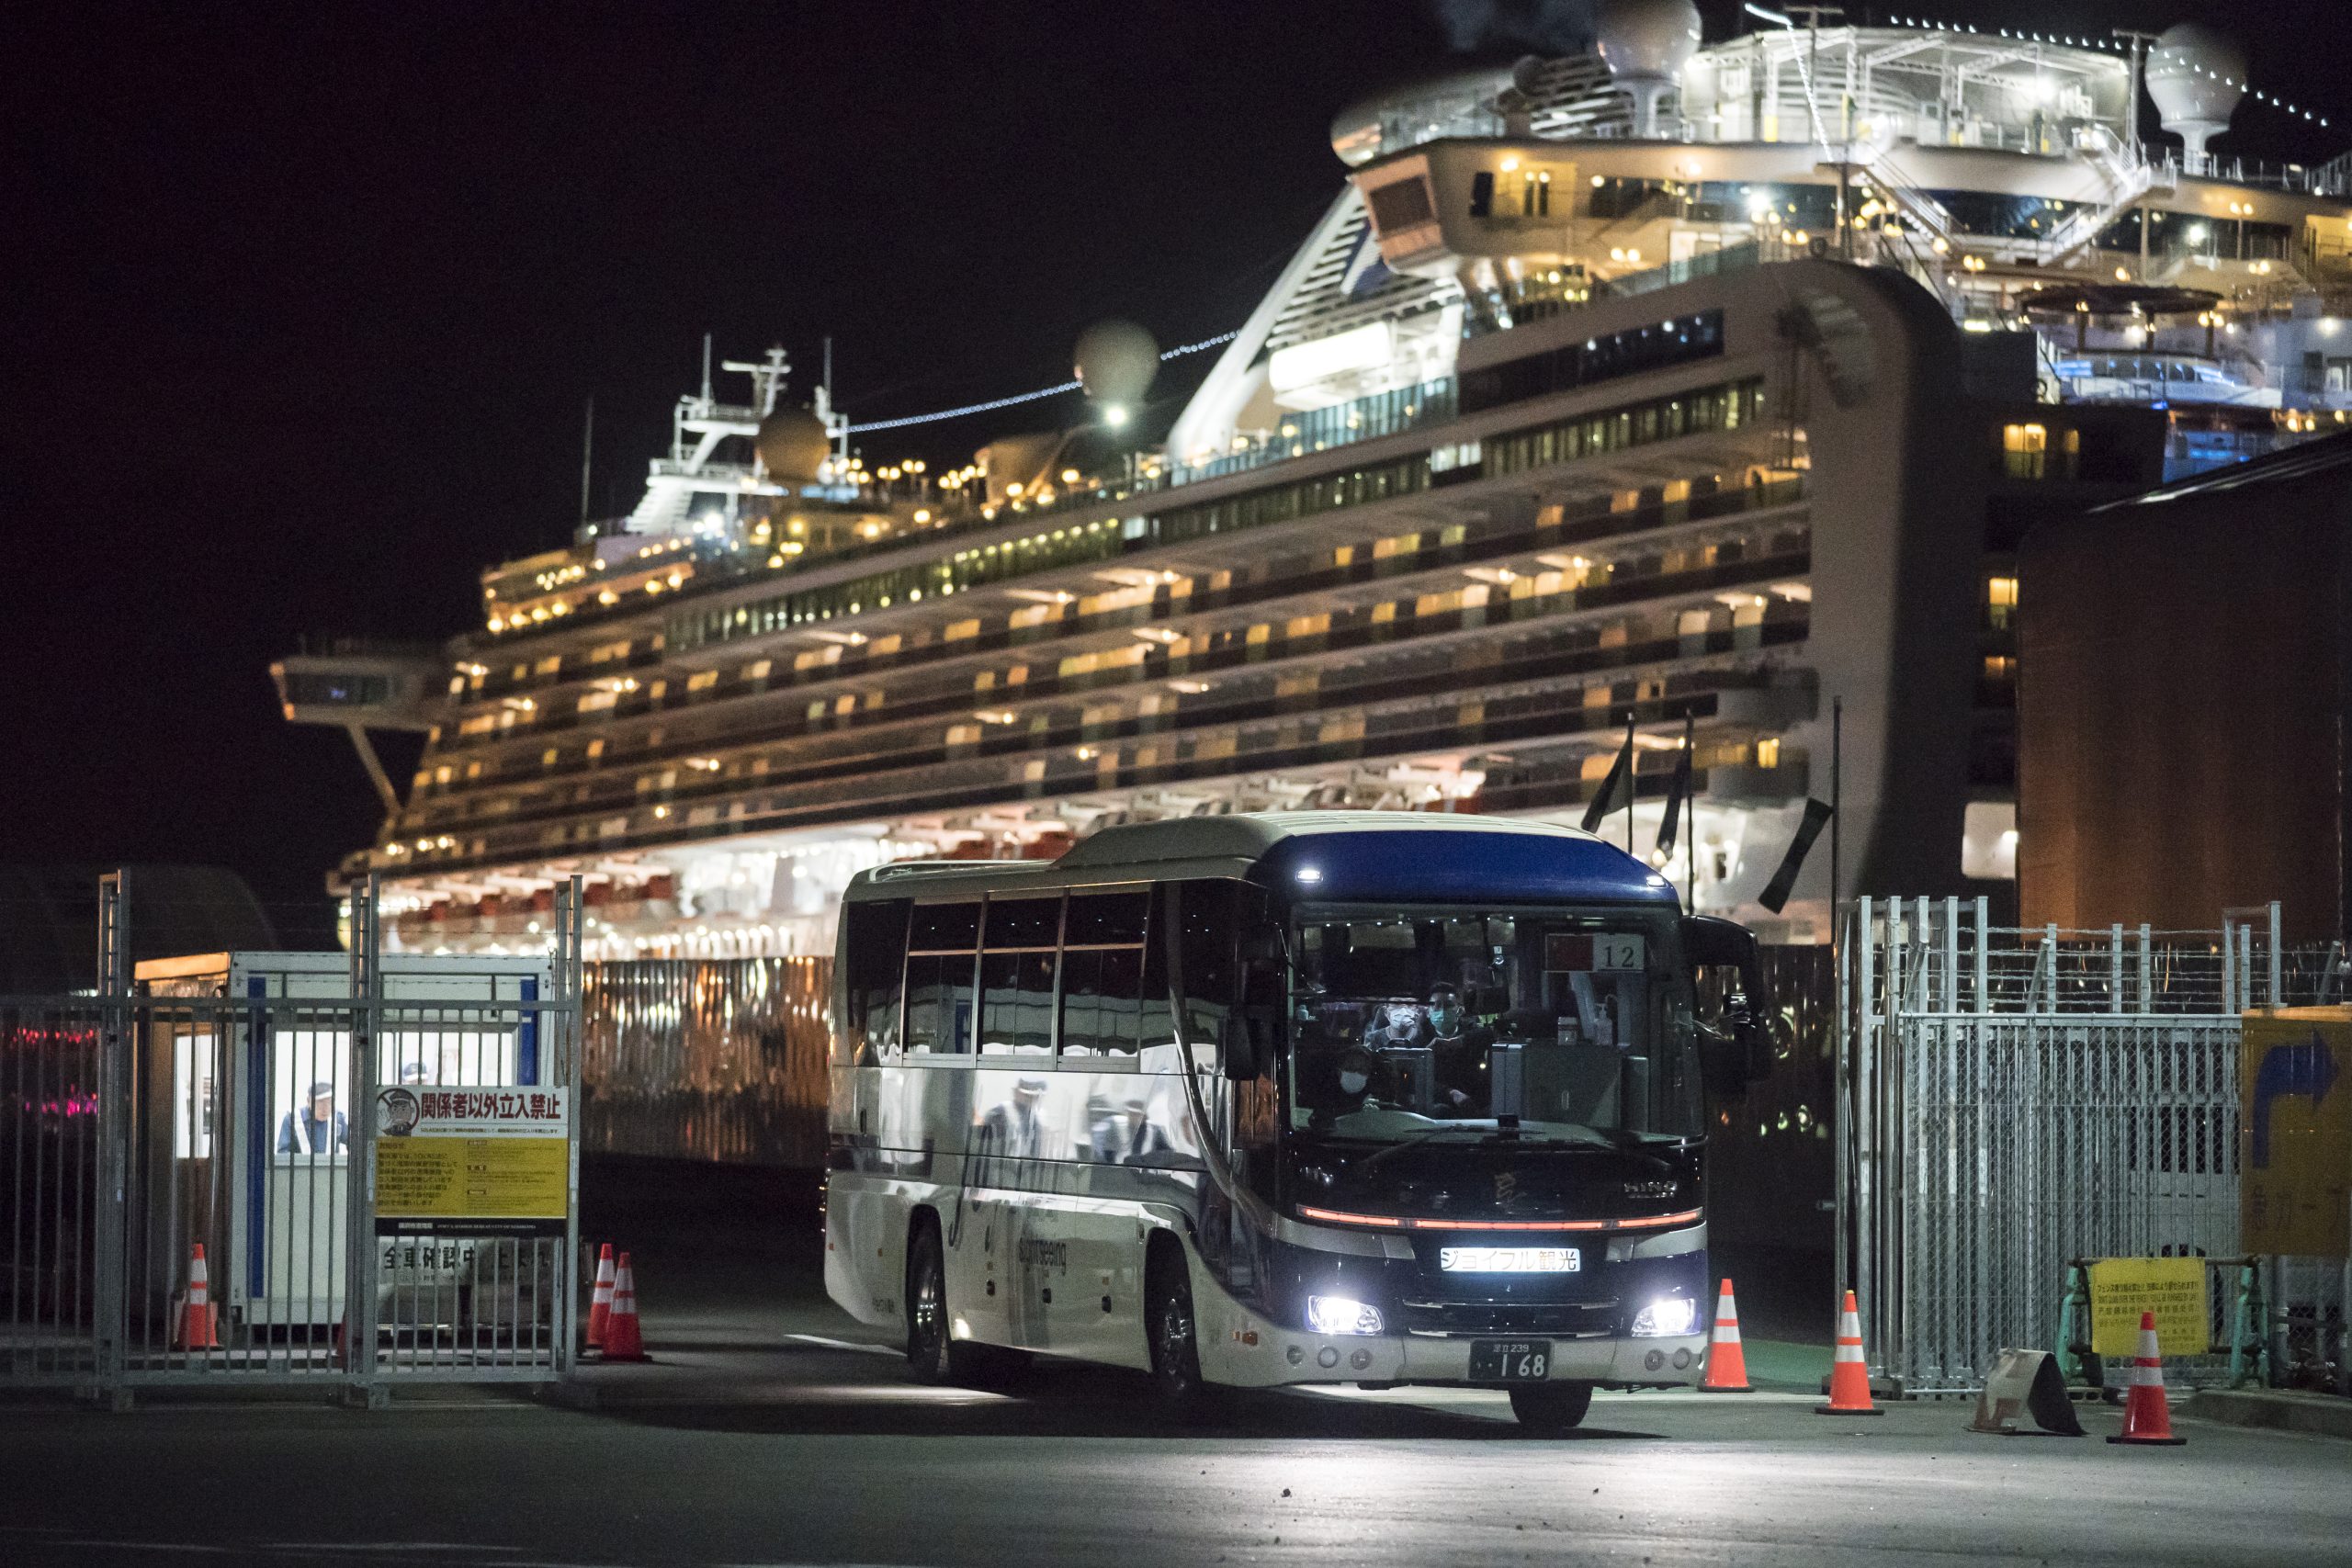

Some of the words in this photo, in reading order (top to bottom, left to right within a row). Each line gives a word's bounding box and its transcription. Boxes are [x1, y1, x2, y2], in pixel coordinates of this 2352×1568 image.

[1605, 945, 1635, 968] 12
[421, 1092, 561, 1121] 関係者以外立入禁止
[1441, 1249, 1577, 1271] ジョイフル観光
